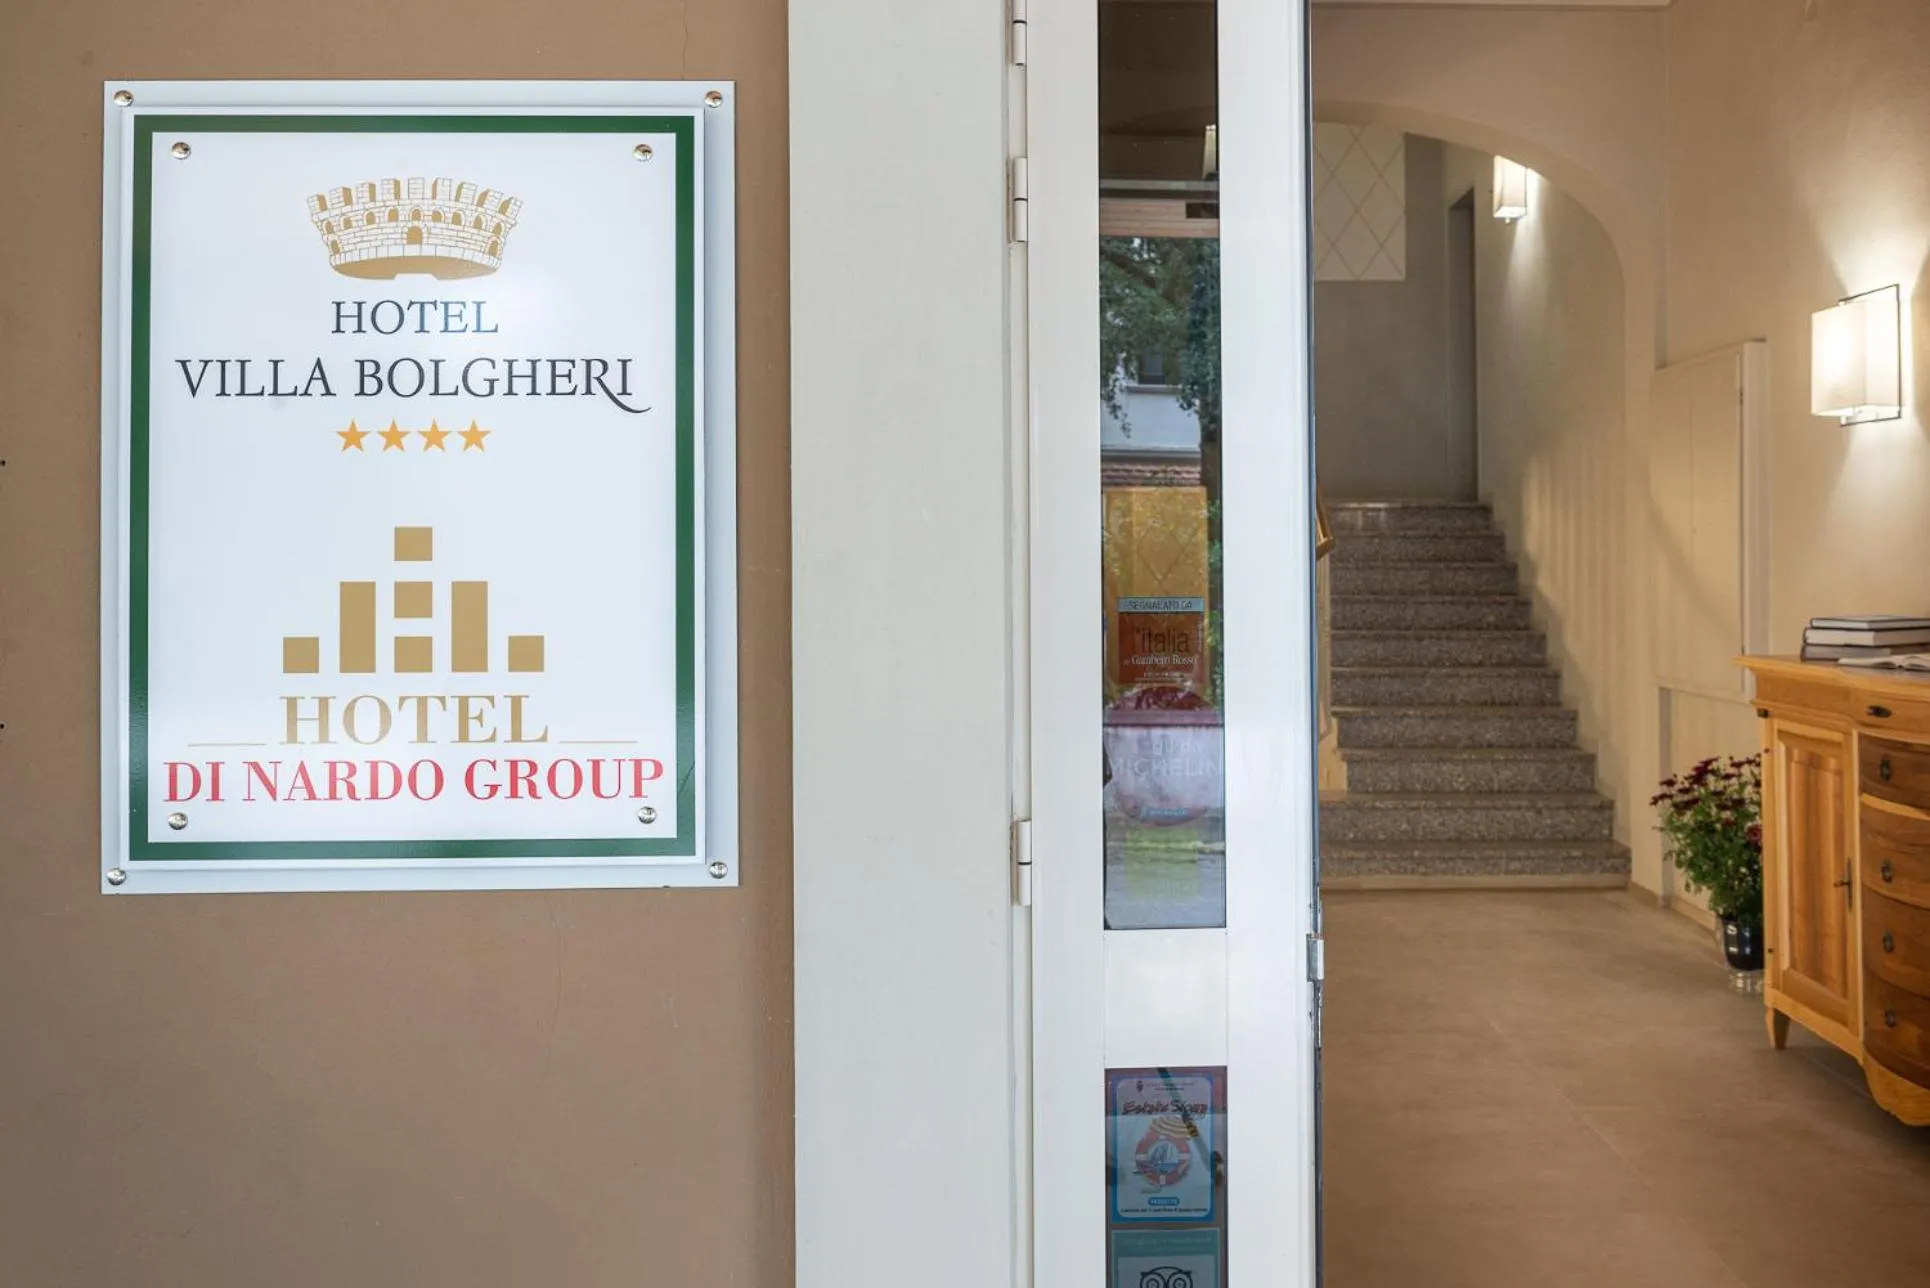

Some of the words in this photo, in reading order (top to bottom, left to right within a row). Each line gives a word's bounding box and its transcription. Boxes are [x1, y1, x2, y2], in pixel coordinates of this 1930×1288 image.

[331, 299, 499, 336] HOTEL
[175, 357, 337, 399] VILLA
[353, 357, 652, 414] BOLGHERI
[278, 694, 549, 745] HOTEL
[163, 761, 225, 803] DI
[242, 759, 445, 802] NARDO
[464, 758, 664, 801] GROUP
